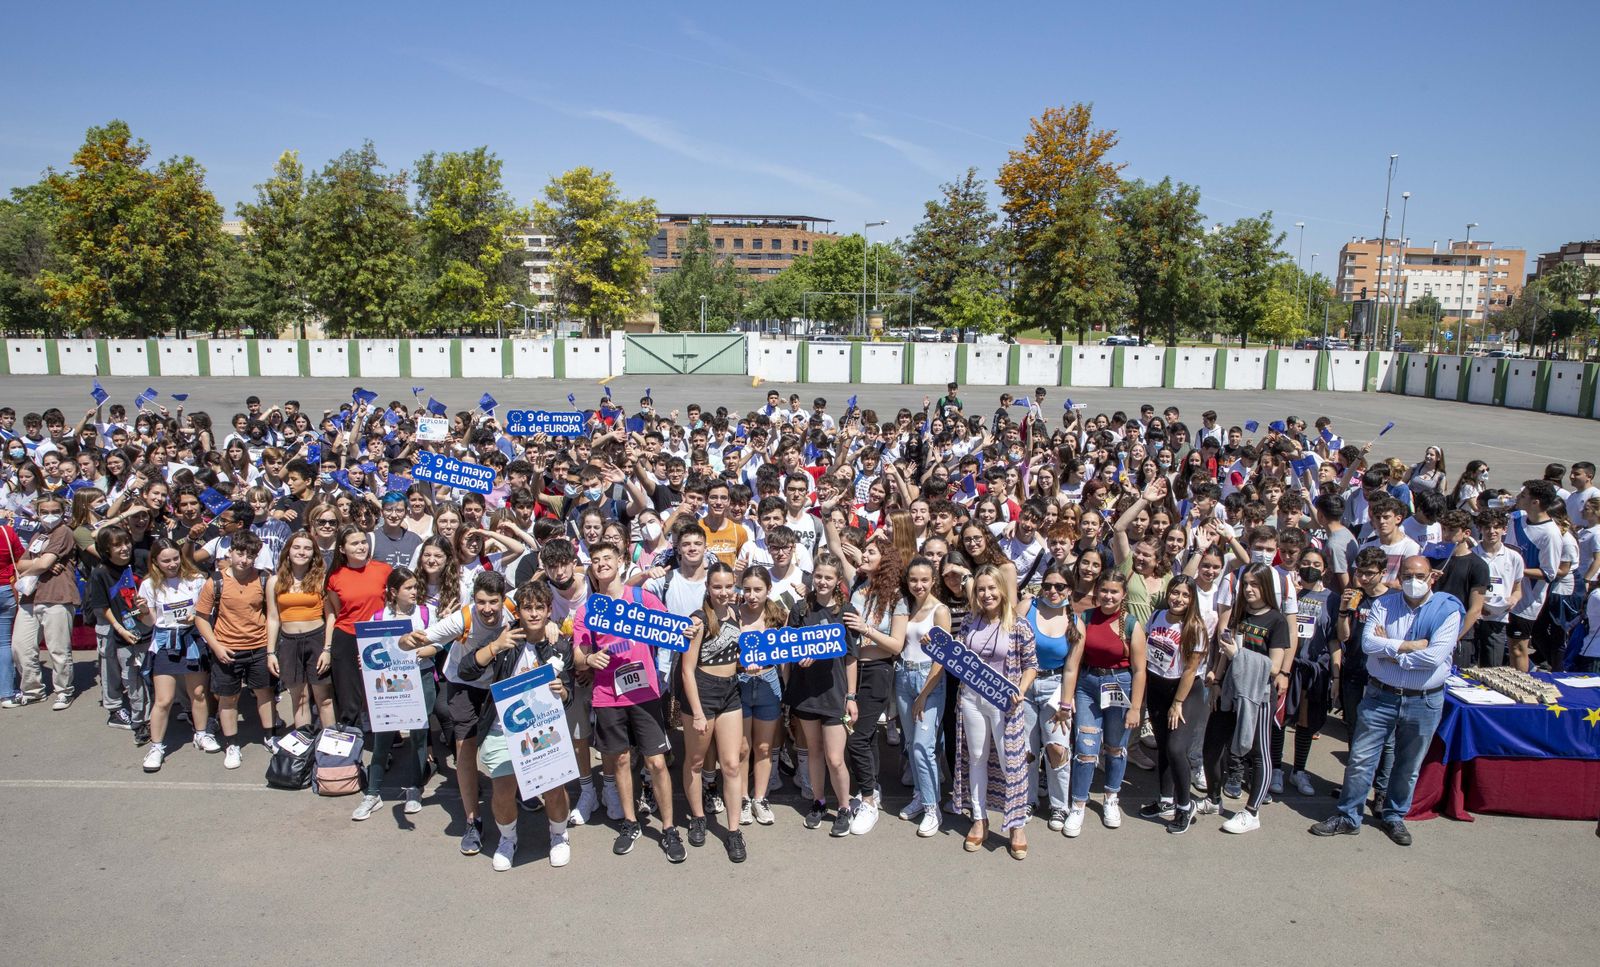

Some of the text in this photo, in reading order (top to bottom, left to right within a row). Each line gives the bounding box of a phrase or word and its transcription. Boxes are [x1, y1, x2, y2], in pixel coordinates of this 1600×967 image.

[527, 413, 581, 424] 9 de mayo
[510, 423, 581, 433] día de EUROPA
[435, 458, 493, 479] 9 de mayo
[414, 466, 489, 491] día de EUROPA
[172, 608, 188, 618] 122
[615, 603, 689, 632] 9 de mayo
[588, 613, 685, 648] día de EUROPA
[766, 627, 841, 645] 9 de mayo
[744, 641, 843, 663] día de EUROPA
[1153, 649, 1165, 662] 55
[622, 672, 640, 686] 109
[925, 640, 1009, 708] día de EUROPA
[951, 645, 1015, 696] 9 de mayo
[1109, 692, 1124, 701] 113
[532, 713, 561, 729] Europea
[532, 752, 547, 761] mayo
